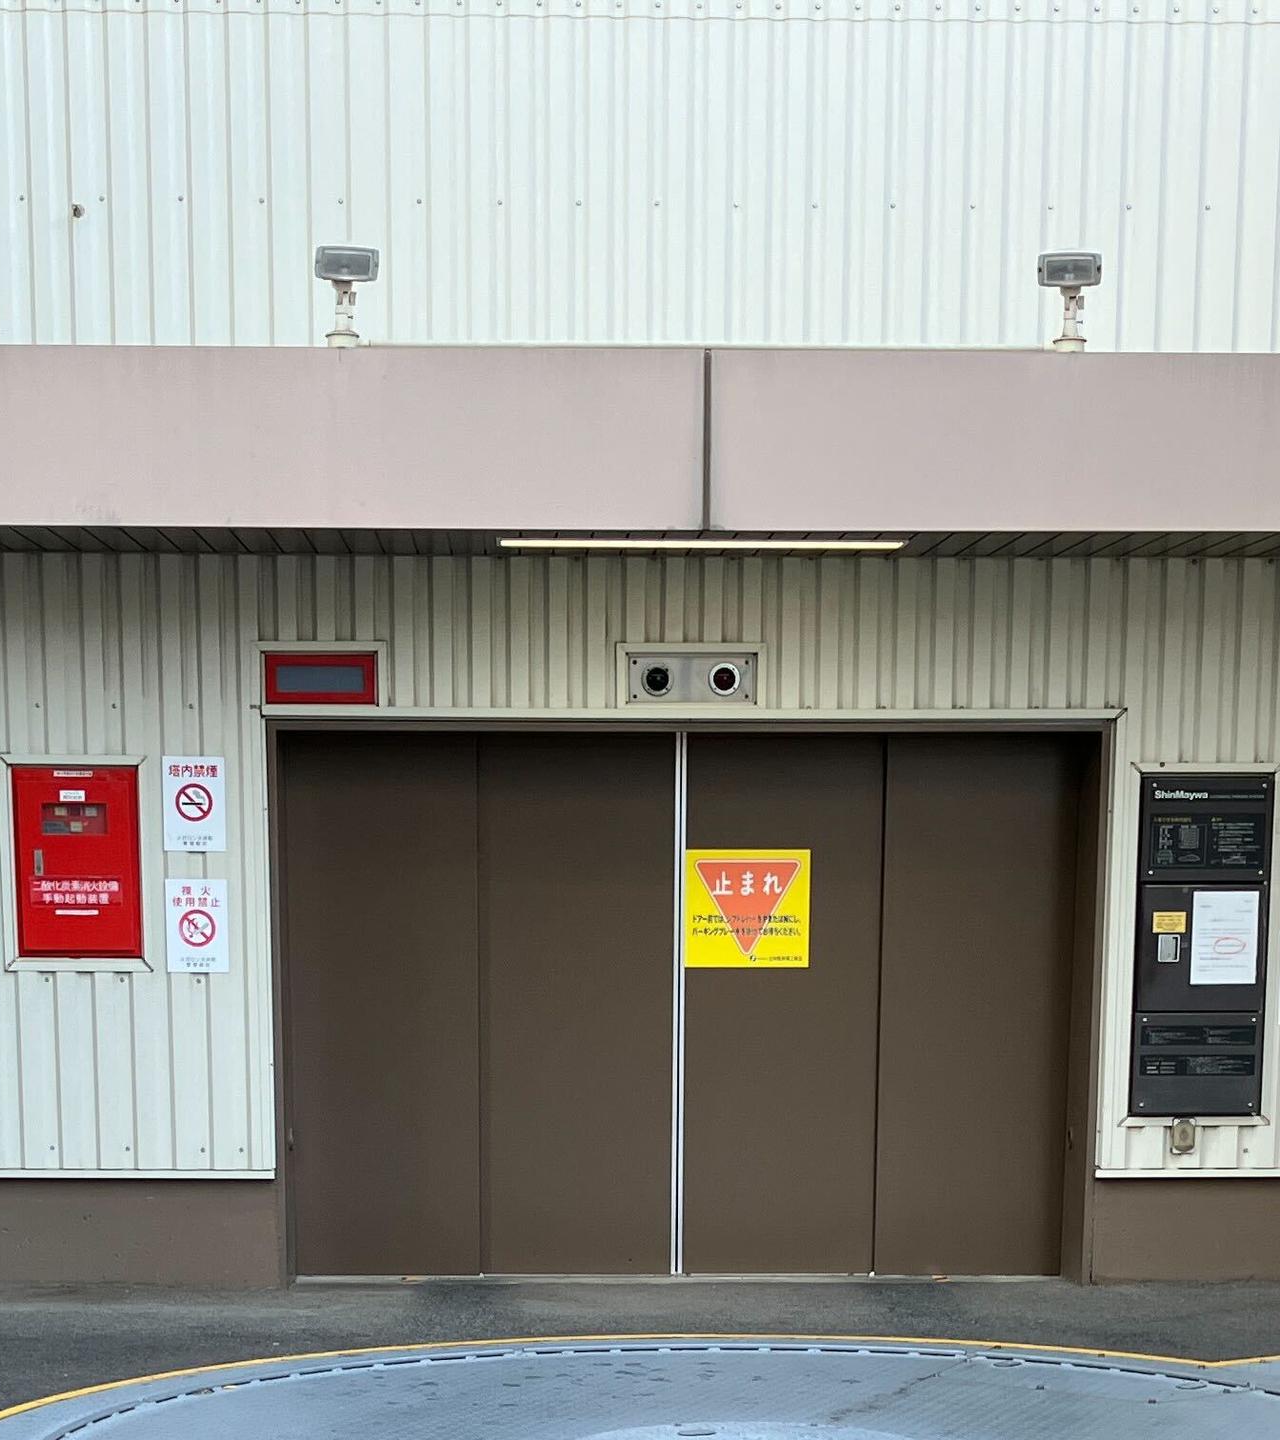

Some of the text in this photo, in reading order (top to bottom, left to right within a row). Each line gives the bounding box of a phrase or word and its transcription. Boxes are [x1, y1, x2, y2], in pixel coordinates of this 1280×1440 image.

[169, 765, 218, 778] 塔内禁煙
[1154, 790, 1209, 801] ShinMaywa
[32, 880, 119, 892] 二酸化炭素消火設備
[712, 871, 783, 896] 止まれ
[42, 893, 110, 905] 手動起動装置
[172, 897, 222, 908] 使用禁止
